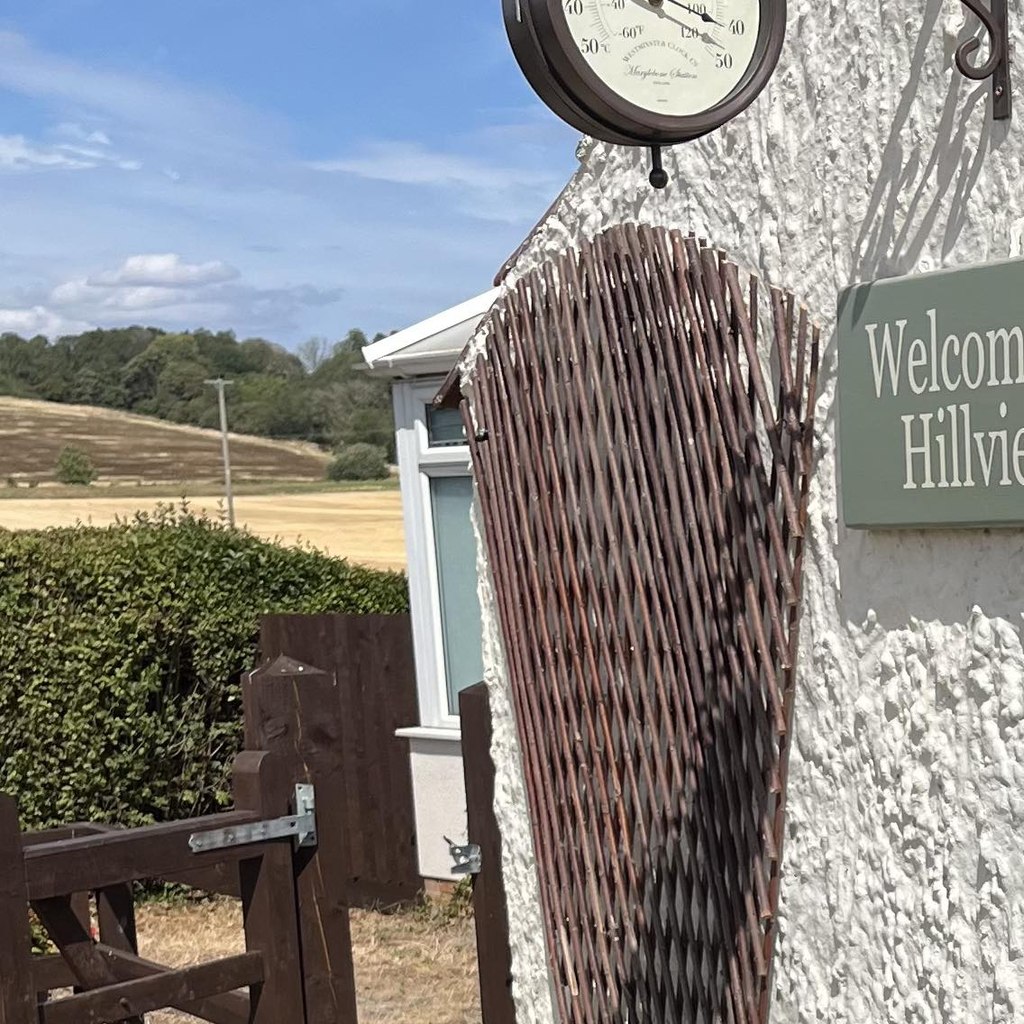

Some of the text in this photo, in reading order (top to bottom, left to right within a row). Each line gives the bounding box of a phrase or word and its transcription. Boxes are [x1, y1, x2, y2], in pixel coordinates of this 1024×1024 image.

[564, 0, 583, 15] 40
[687, 3, 706, 14] 100
[681, 26, 699, 38] 120
[728, 19, 745, 35] 40
[715, 53, 733, 69] 50
